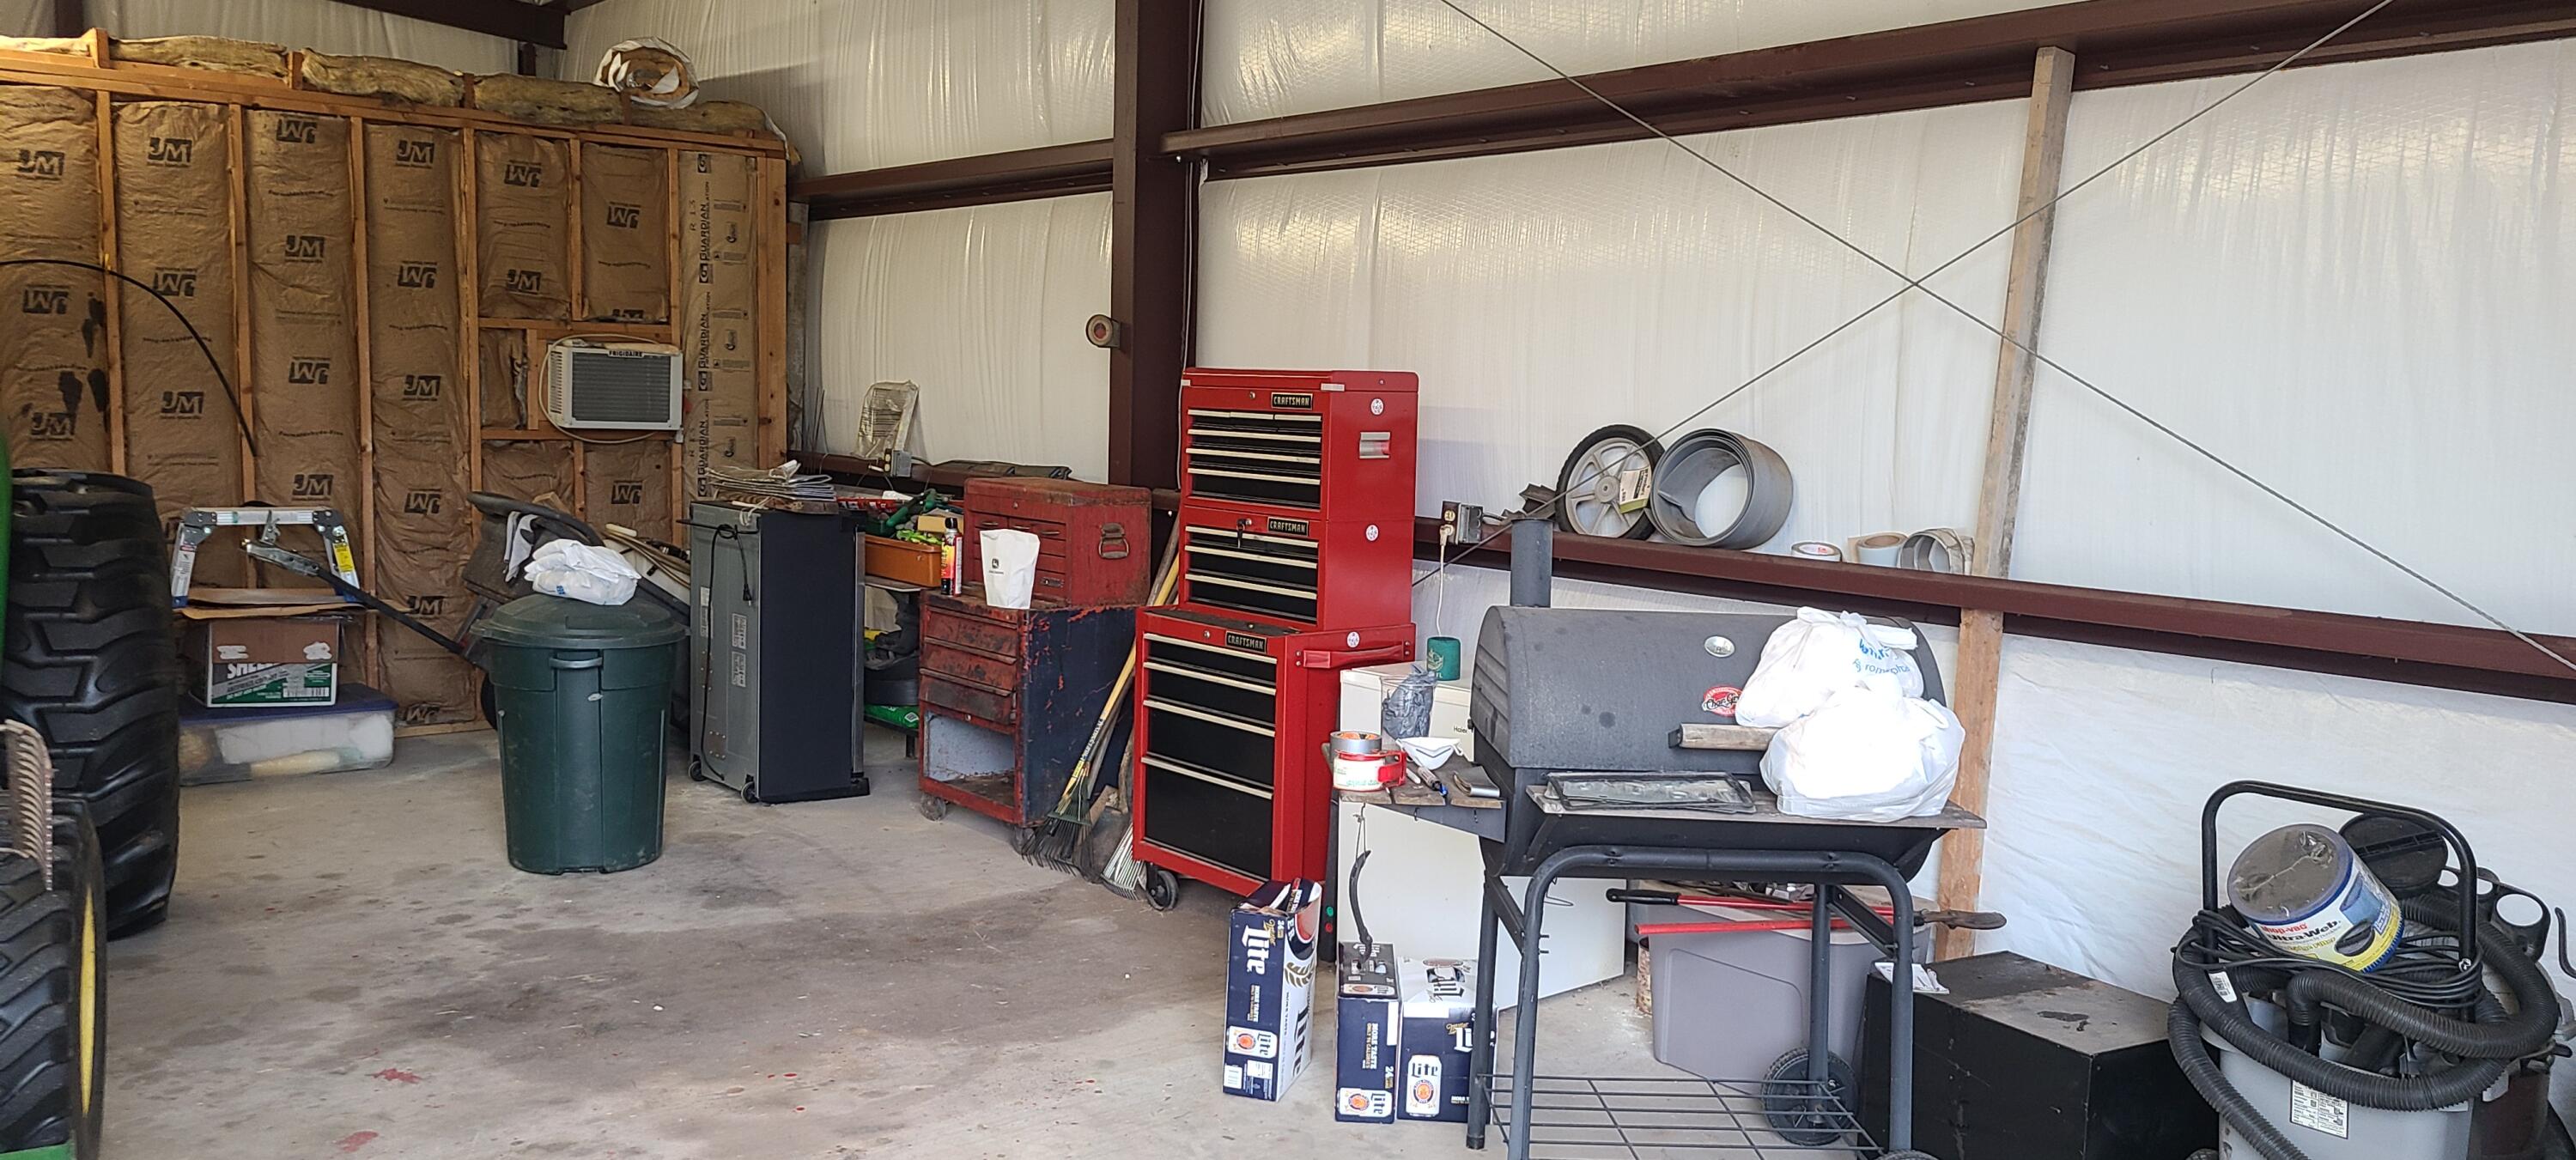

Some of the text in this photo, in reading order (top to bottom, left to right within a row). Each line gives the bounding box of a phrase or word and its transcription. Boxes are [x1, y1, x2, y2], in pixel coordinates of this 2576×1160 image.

[699, 203, 708, 261] GUARDIAN
[698, 313, 707, 369] GUARDIAN
[1273, 396, 1310, 406] CRAFTSMAN
[1270, 520, 1306, 533] CRAFTSMAN
[1228, 635, 1264, 650] CRAFTSMAN
[1242, 925, 1271, 975] Lite
[1258, 1033, 1271, 1055] Lite
[1293, 1005, 1309, 1077] Lite
[1385, 1066, 1394, 1078] 24
[1411, 1063, 1437, 1078] Lite
[1371, 1093, 1386, 1114] Lite
